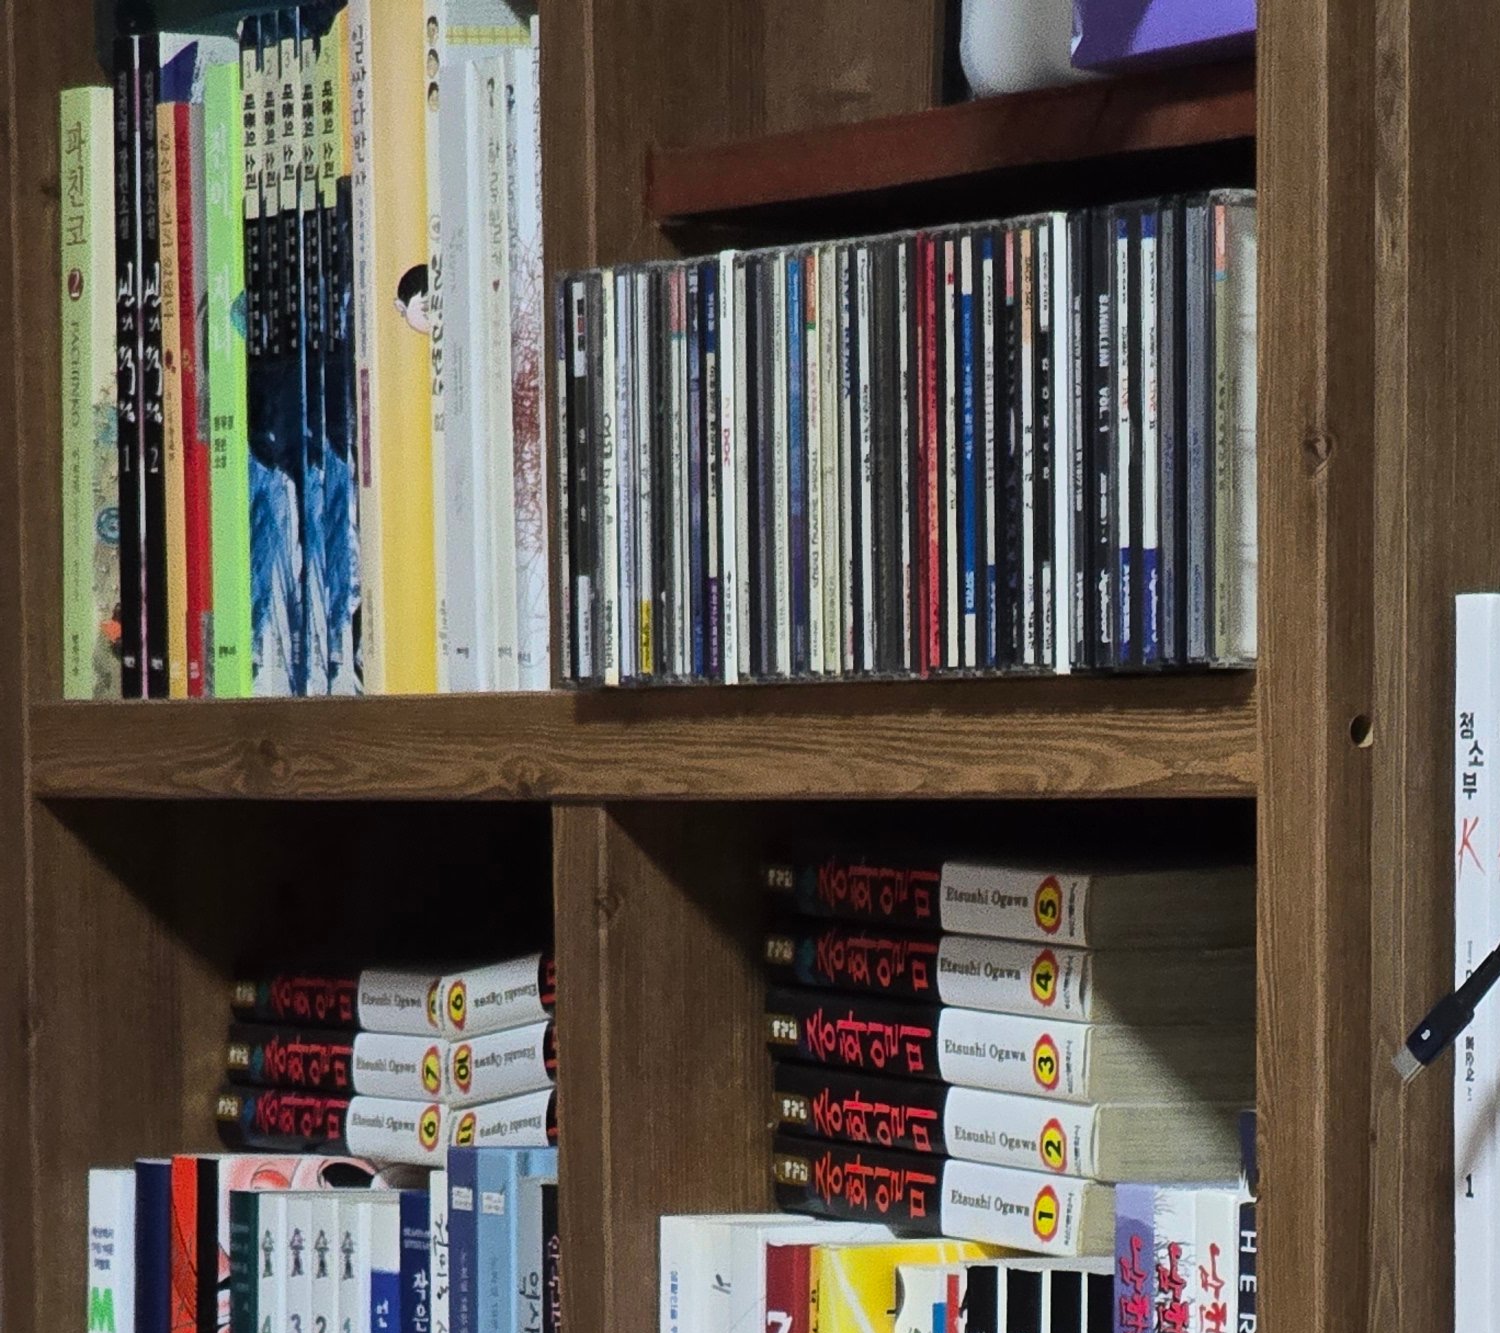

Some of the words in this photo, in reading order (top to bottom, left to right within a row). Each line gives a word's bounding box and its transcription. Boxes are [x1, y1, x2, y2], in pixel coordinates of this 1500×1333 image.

[64, 121, 87, 247] 파친코
[1459, 712, 1484, 800] 청소부
[1458, 816, 1486, 881] K
[945, 886, 989, 903] Etsushi
[991, 890, 1029, 909] Ogawa
[1039, 900, 1057, 919] 5
[988, 1043, 1027, 1062] Ogawa
[411, 1269, 429, 1331] 작은
